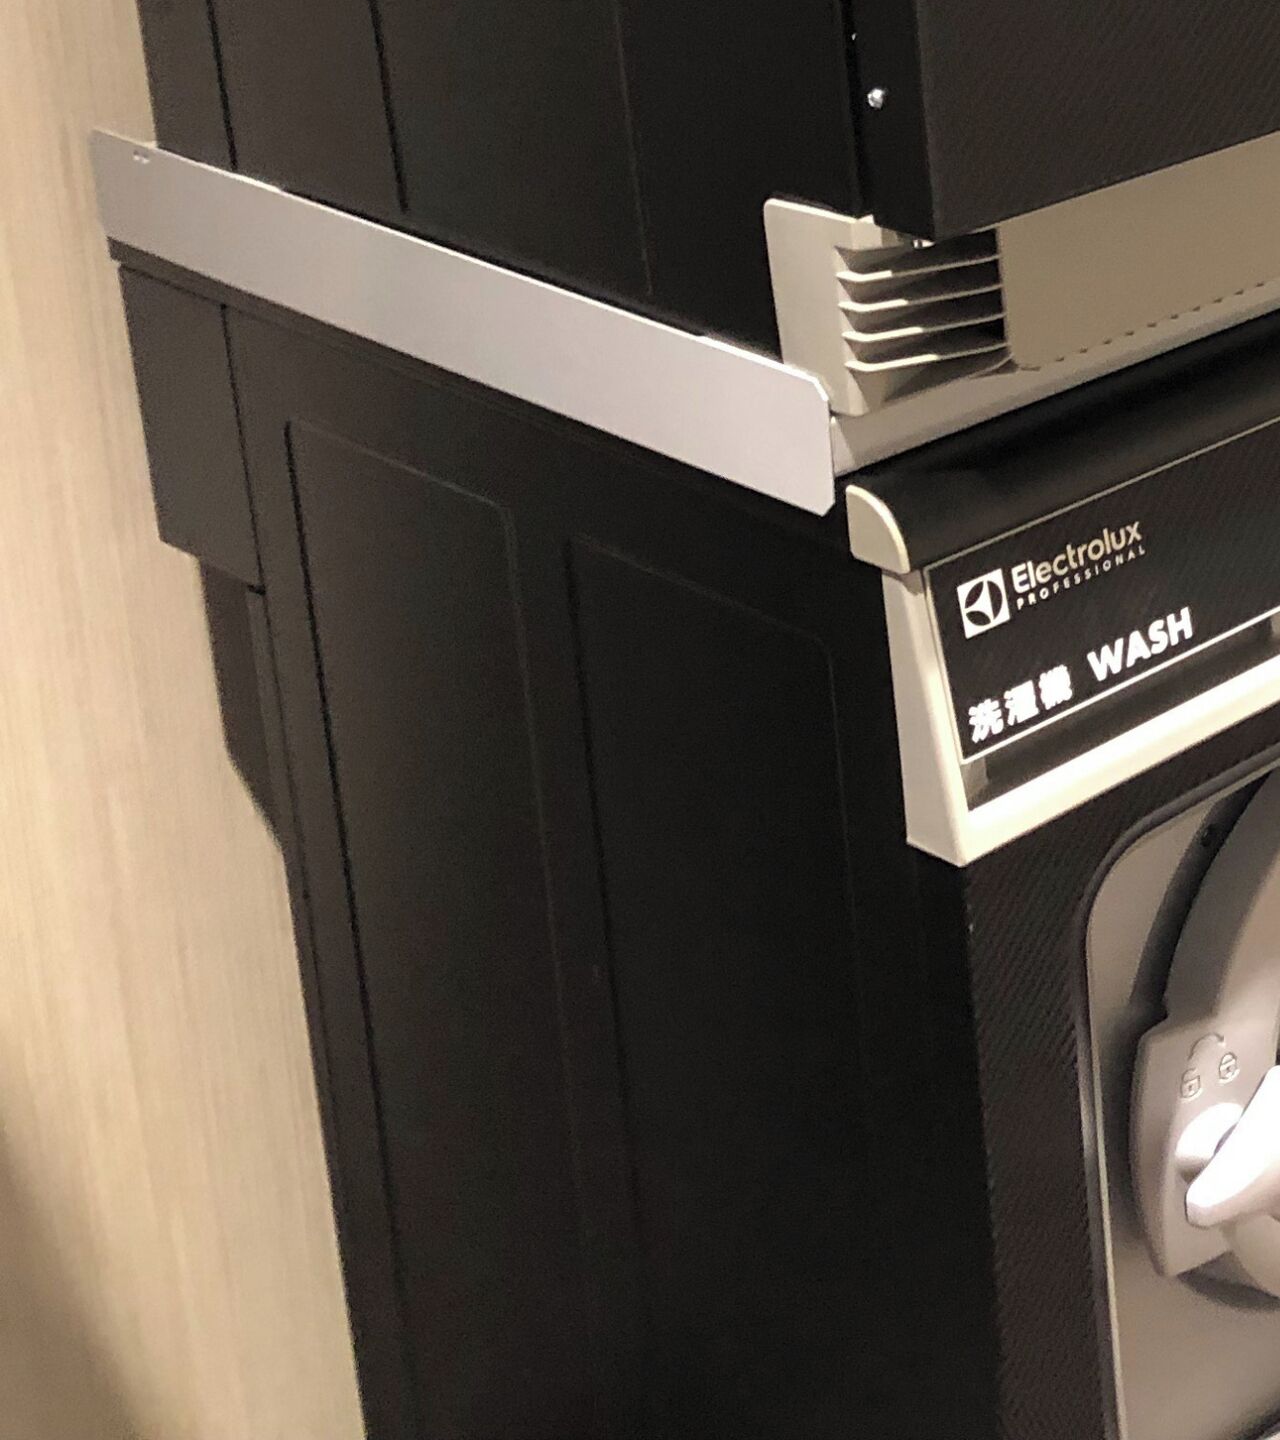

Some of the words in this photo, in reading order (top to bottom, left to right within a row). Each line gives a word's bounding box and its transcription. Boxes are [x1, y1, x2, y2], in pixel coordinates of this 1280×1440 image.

[1011, 521, 1143, 594] Electrolux
[1016, 545, 1146, 611] PROFESSIONAL
[1087, 606, 1193, 682] WASH
